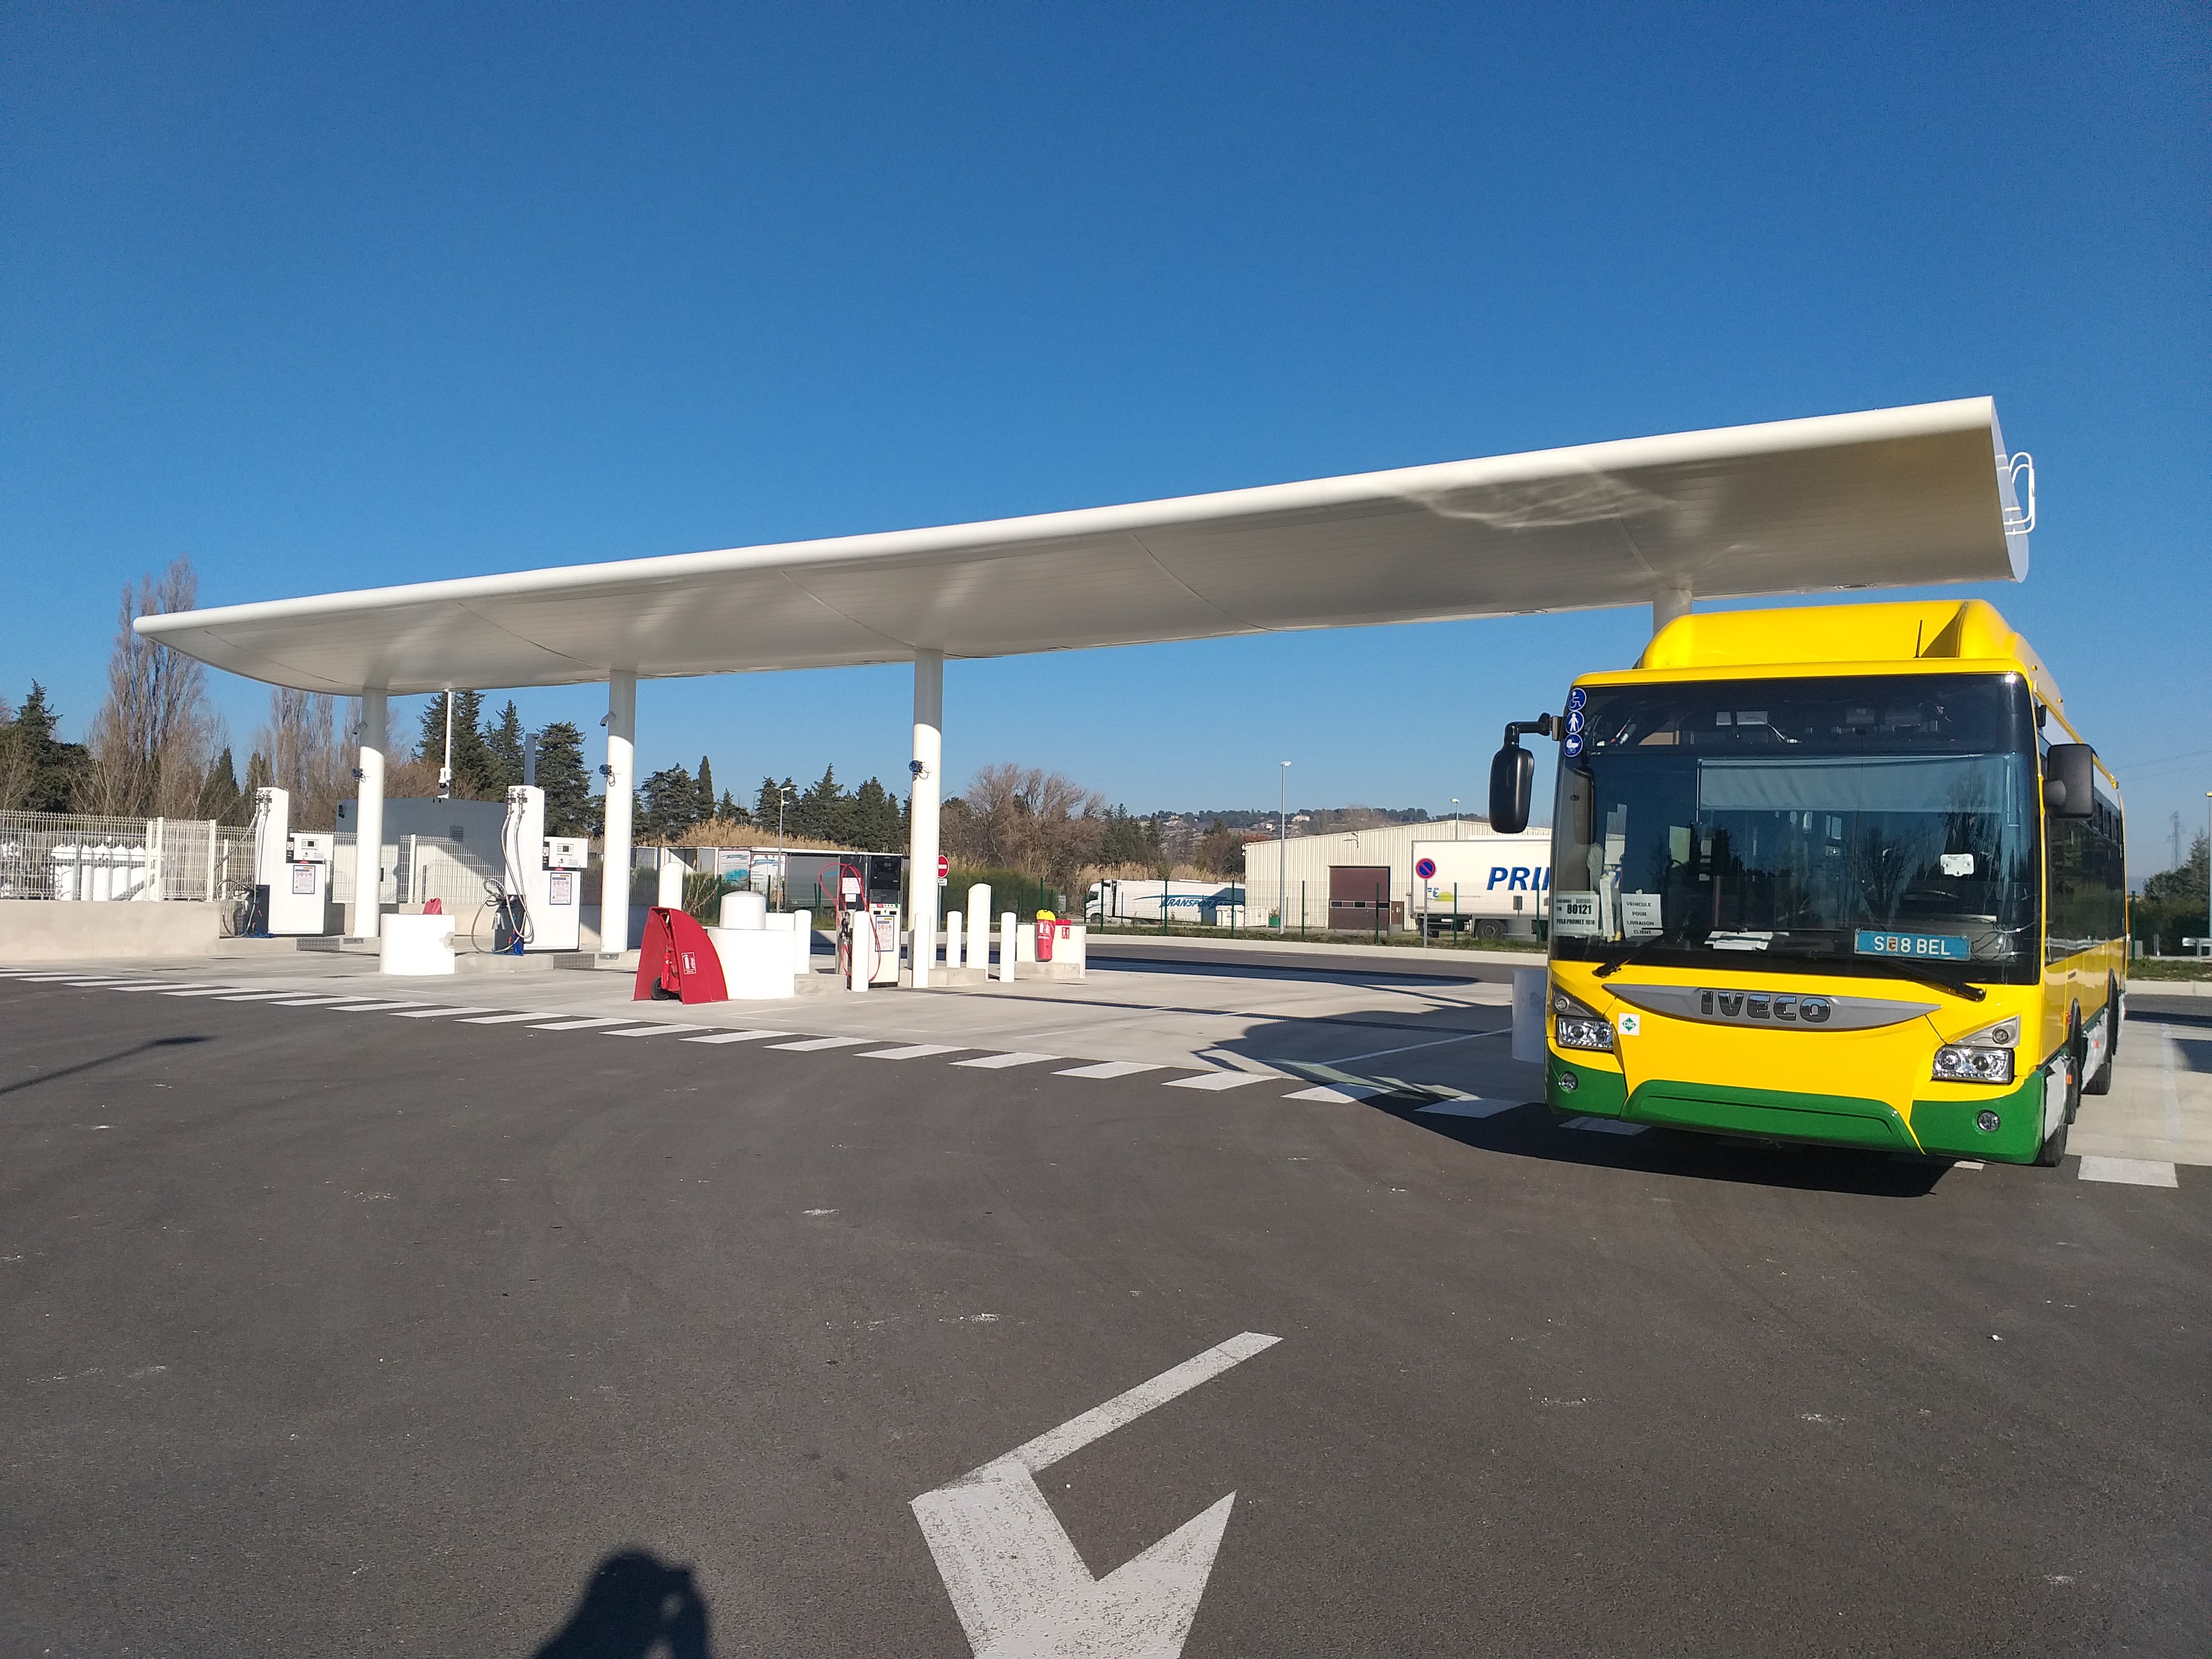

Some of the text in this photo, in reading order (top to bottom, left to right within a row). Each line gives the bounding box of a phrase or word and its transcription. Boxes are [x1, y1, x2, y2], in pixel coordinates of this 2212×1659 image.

[1567, 904, 1592, 914] 80121
[1916, 938, 1951, 956] BEL
[1701, 991, 1831, 1023] IVECO
